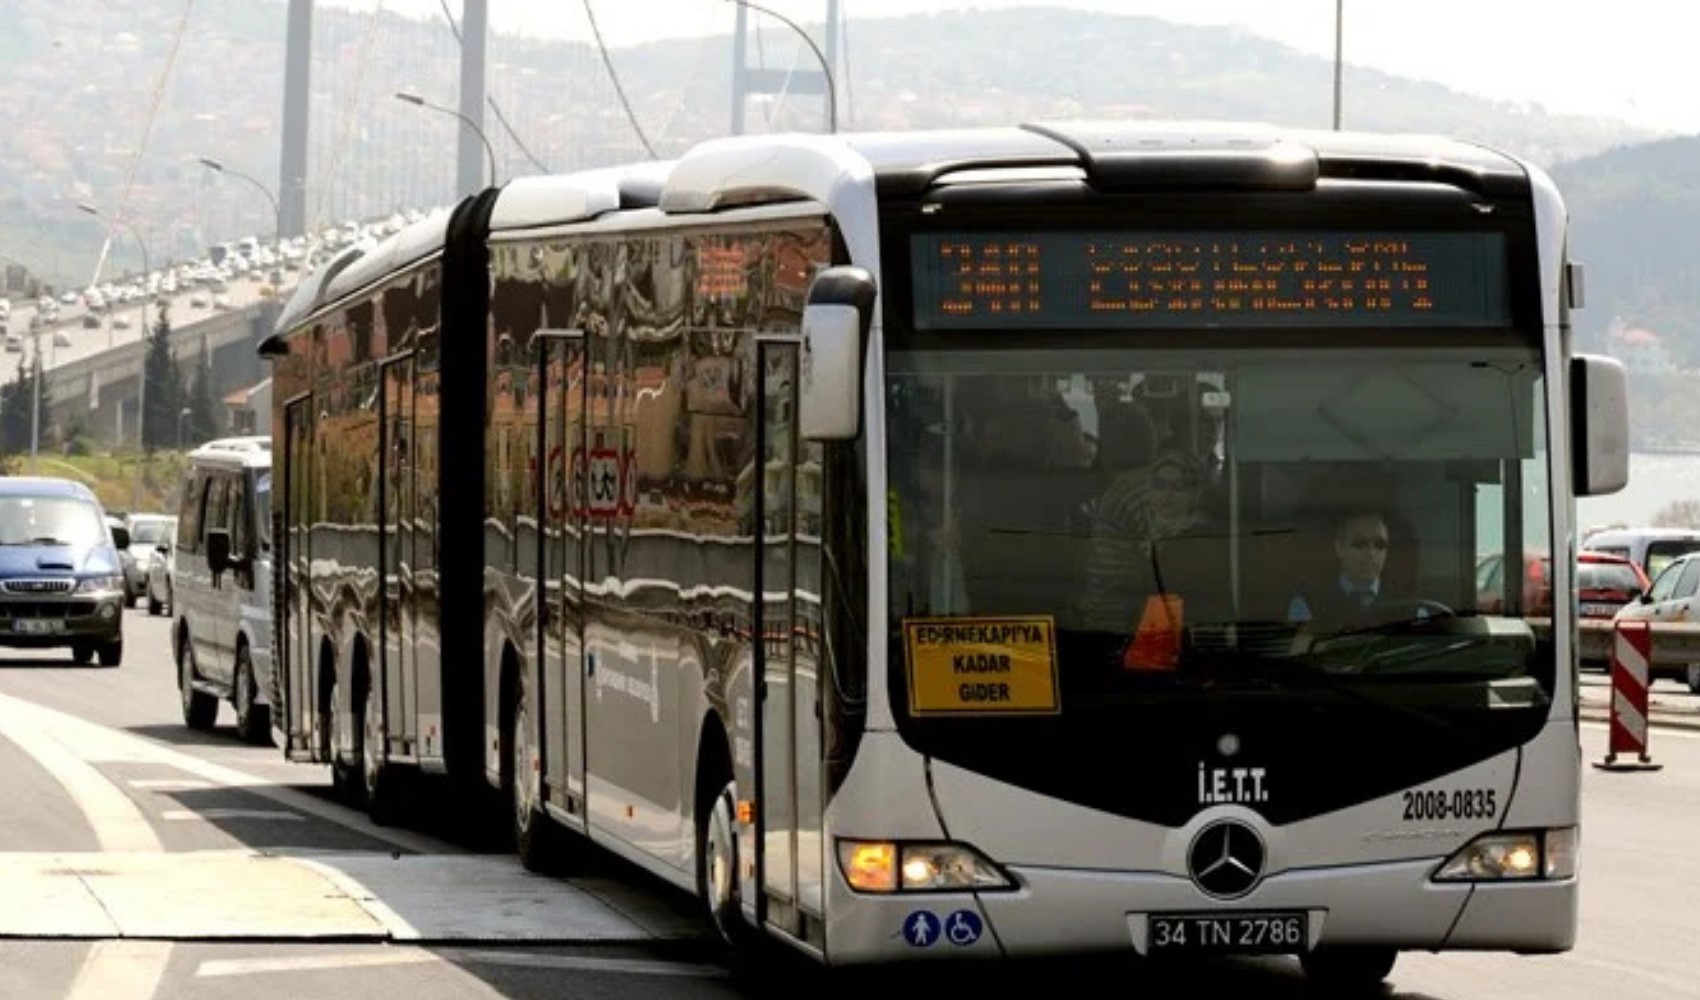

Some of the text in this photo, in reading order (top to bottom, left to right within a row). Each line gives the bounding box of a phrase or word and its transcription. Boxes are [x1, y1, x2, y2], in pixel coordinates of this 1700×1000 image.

[953, 654, 1011, 673] KADAR
[1403, 789, 1496, 820] 2008-0835
[1155, 918, 1300, 946] 34 TN 2786
